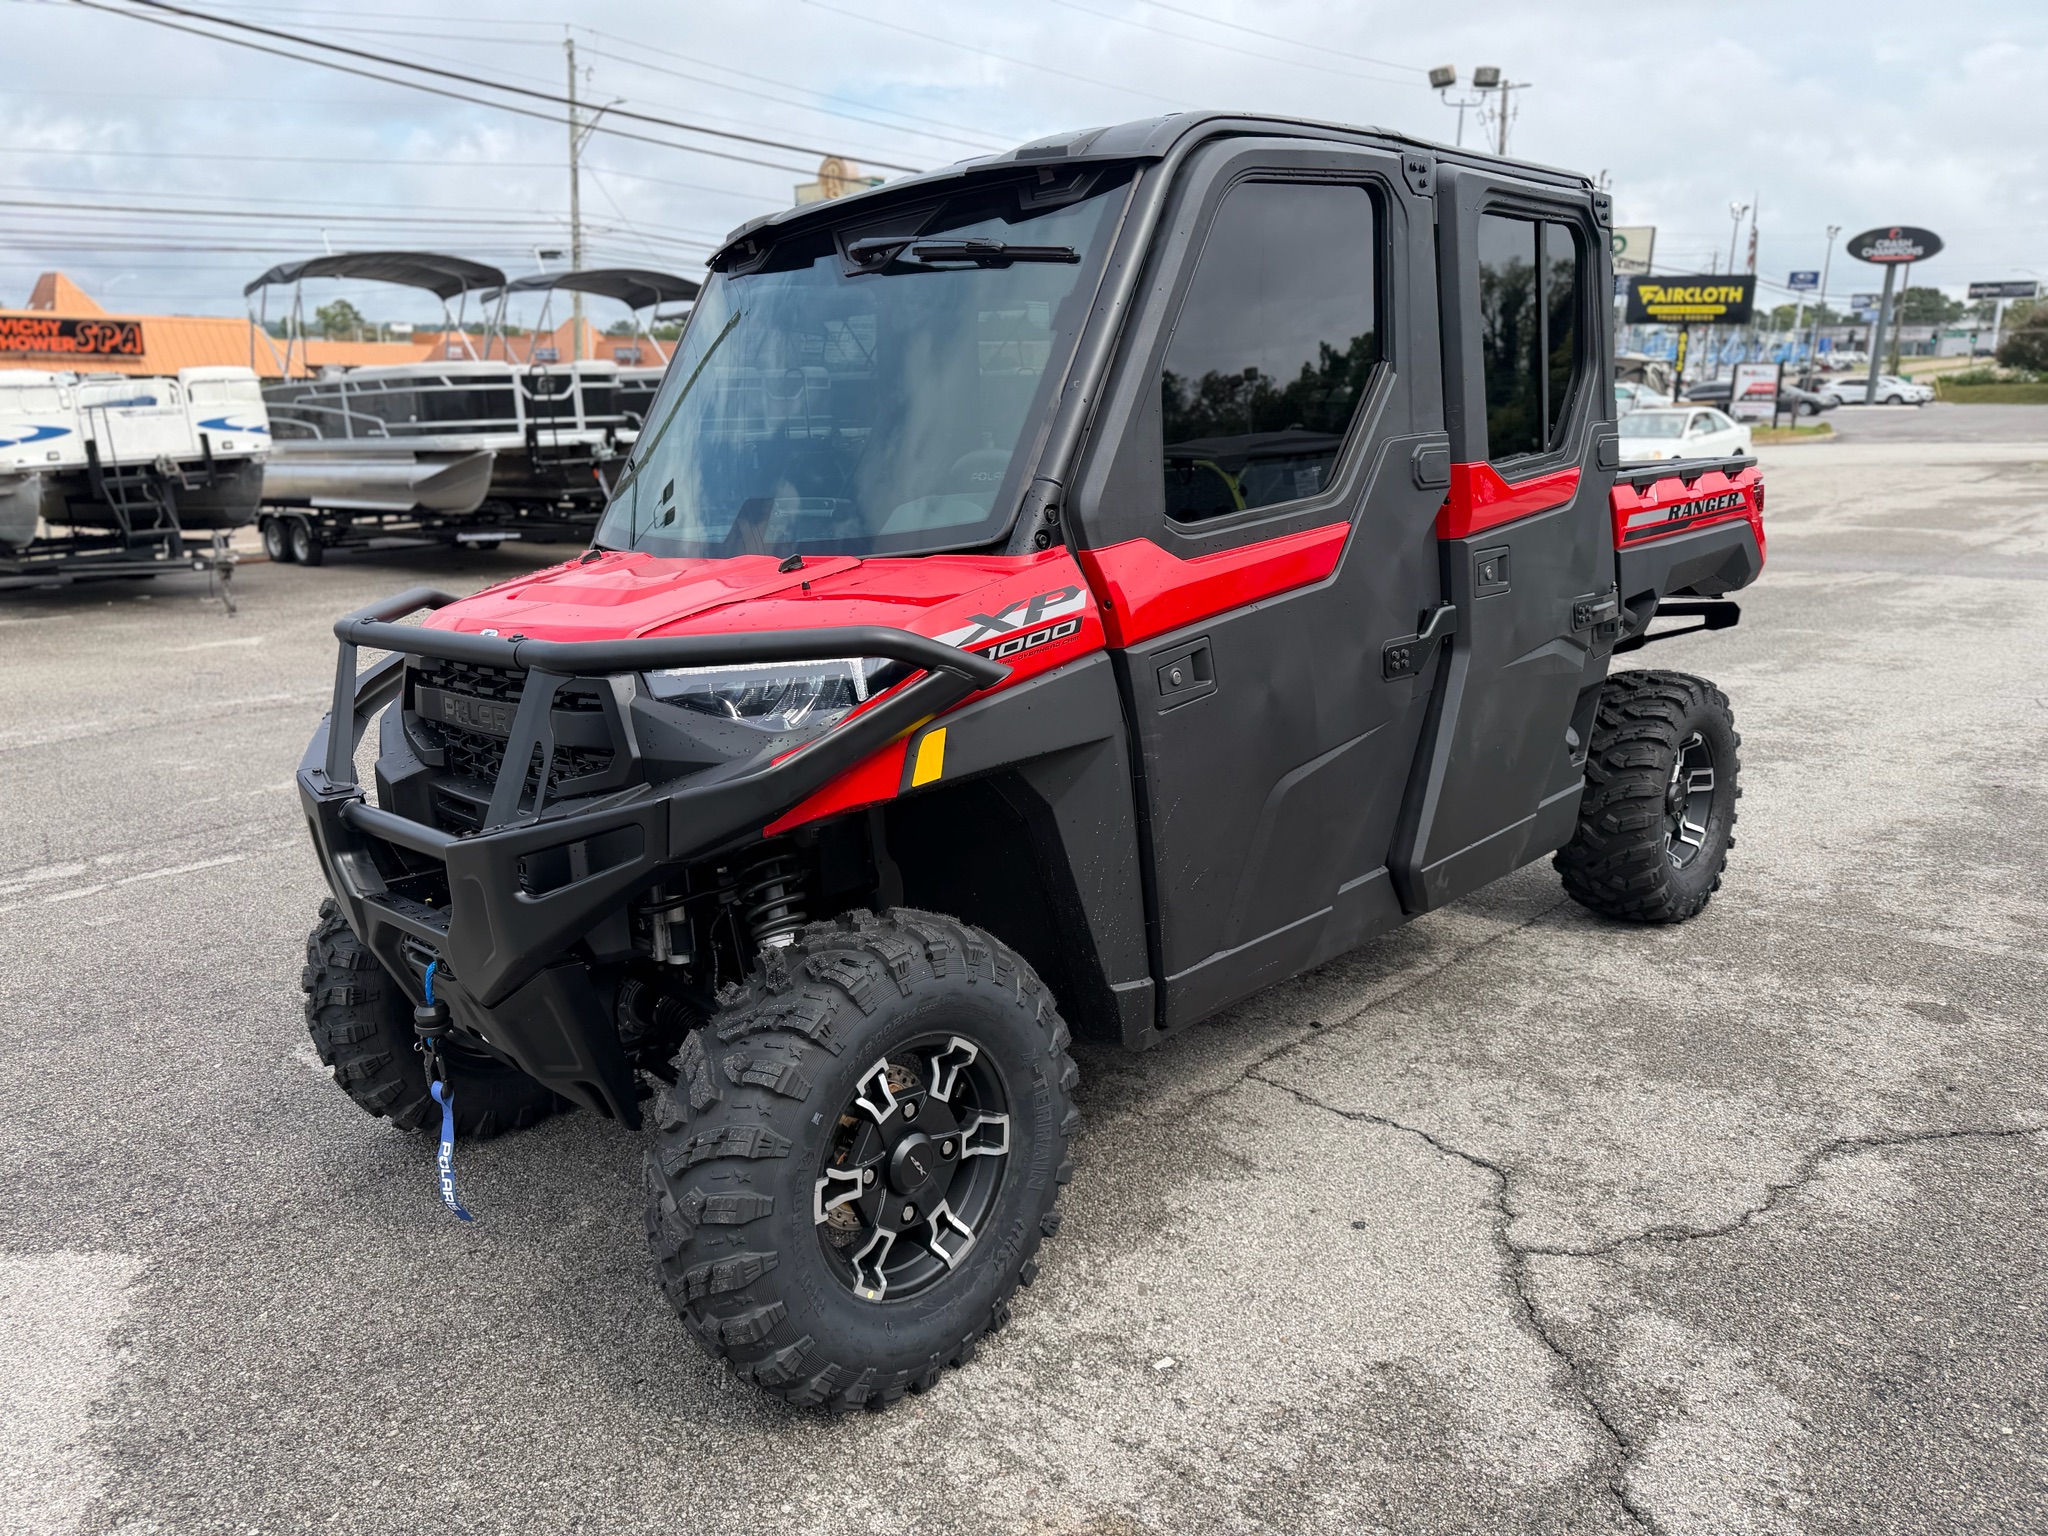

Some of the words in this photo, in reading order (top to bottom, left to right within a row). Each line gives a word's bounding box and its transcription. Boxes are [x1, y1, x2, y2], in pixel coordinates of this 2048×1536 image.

[1861, 246, 1924, 257] CHAMPIONS
[1874, 239, 1914, 248] CRASH
[1637, 284, 1744, 304] FAIRCLOTH
[75, 320, 142, 354] SPA
[971, 471, 1006, 482] POLAR
[1667, 491, 1739, 521] RANGER
[956, 585, 1083, 647] XP
[988, 619, 1078, 661] 1000
[1017, 642, 1061, 660] OVERHEAD
[1062, 636, 1080, 645] CAM
[443, 696, 517, 733] POLAR
[1020, 1047, 1053, 1191] X-TERRAIN
[438, 1141, 461, 1212] POLARIS
